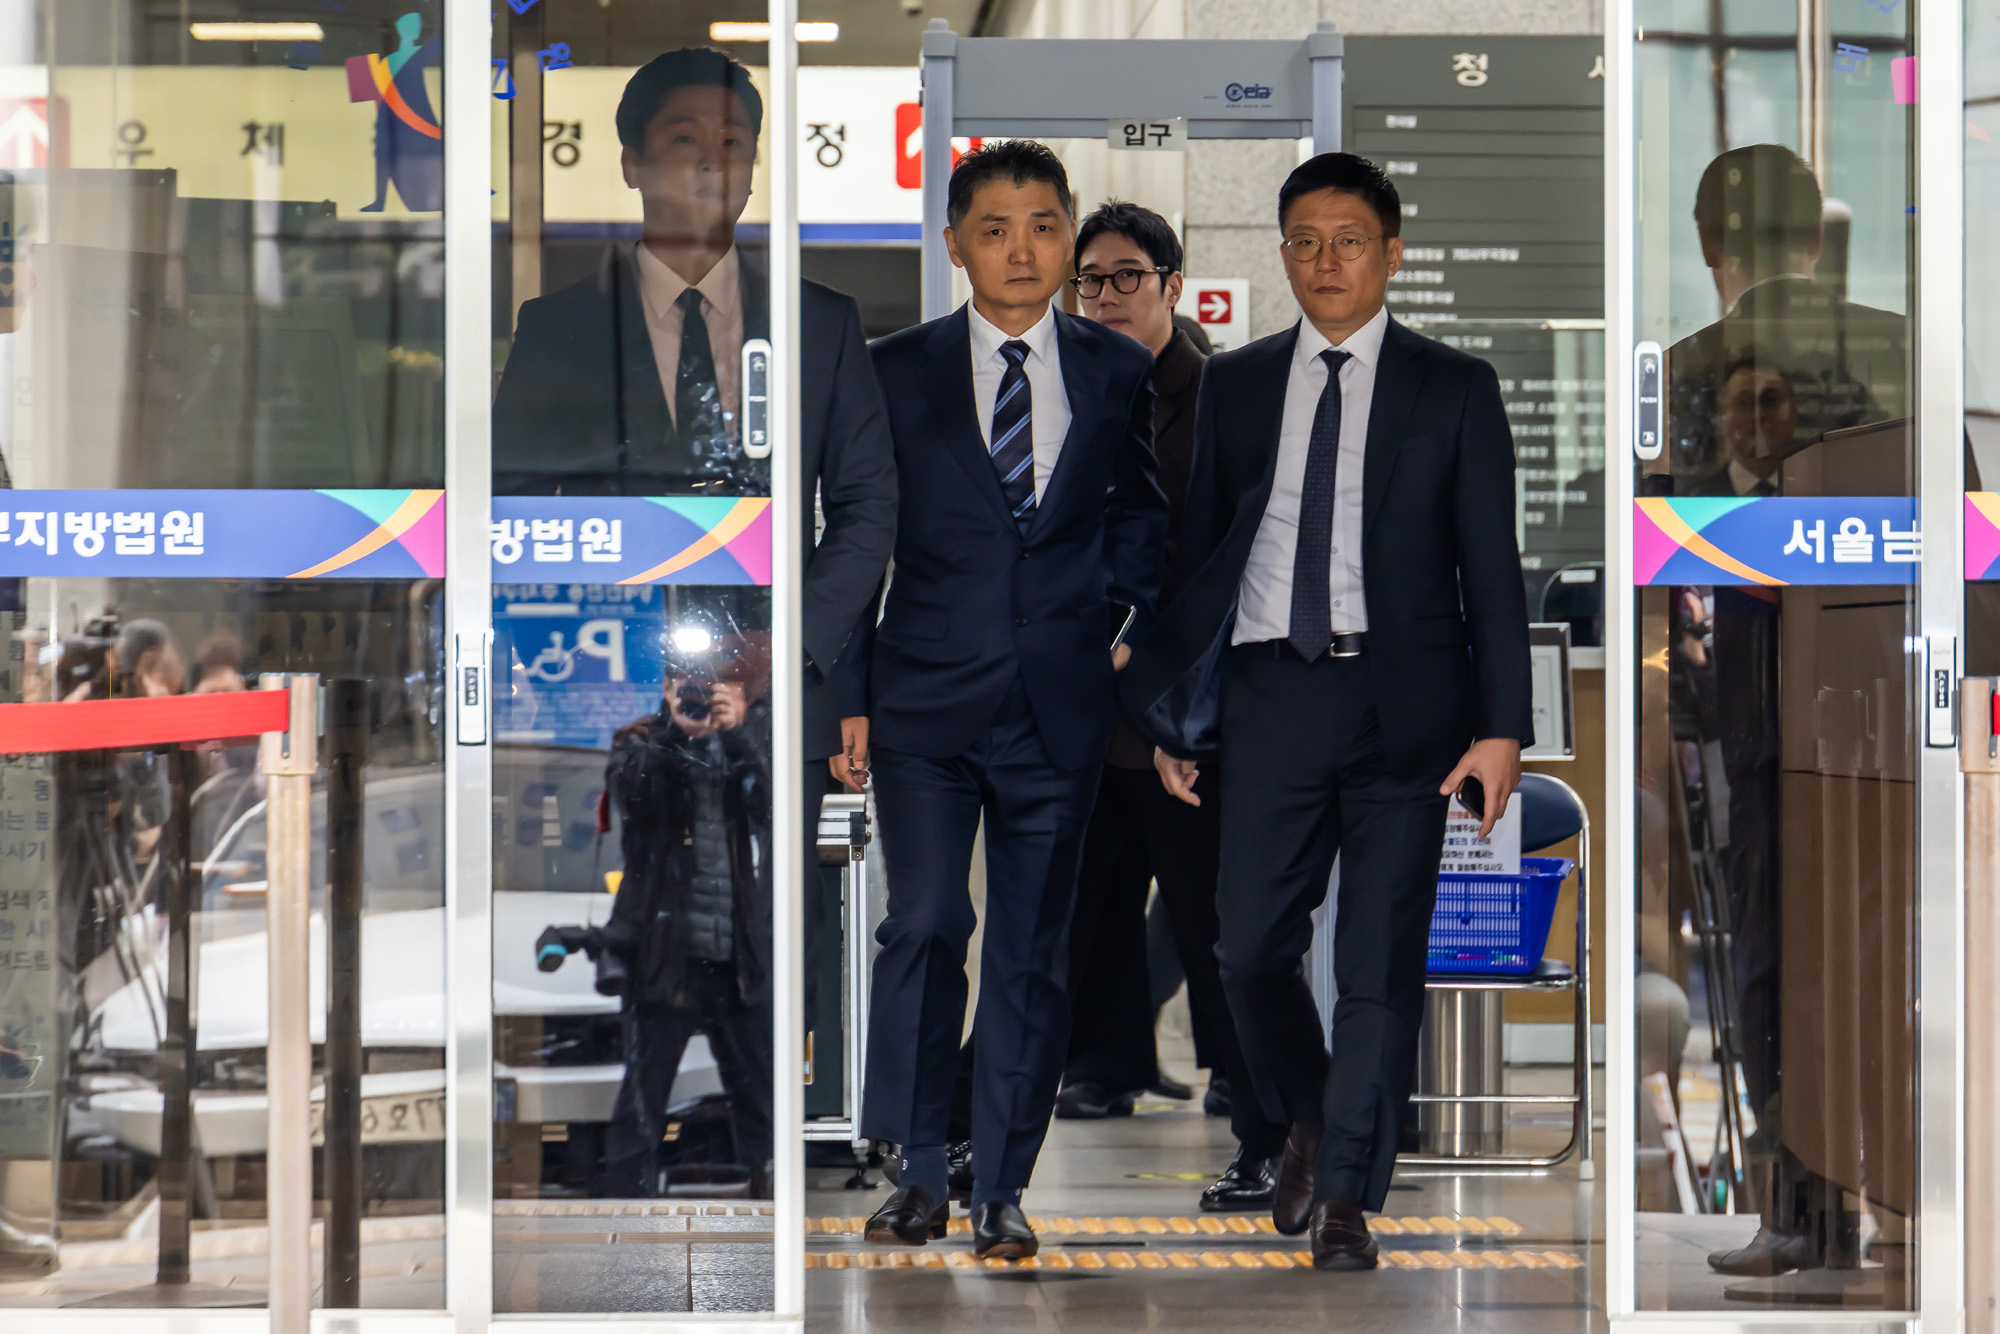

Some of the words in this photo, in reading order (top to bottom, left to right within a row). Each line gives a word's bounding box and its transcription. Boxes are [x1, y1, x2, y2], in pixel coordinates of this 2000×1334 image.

[241, 120, 285, 167] 체
[806, 123, 847, 168] 정
[1123, 122, 1172, 148] 입구
[1640, 396, 1658, 404] PUSH
[0, 510, 205, 557] 지방법원
